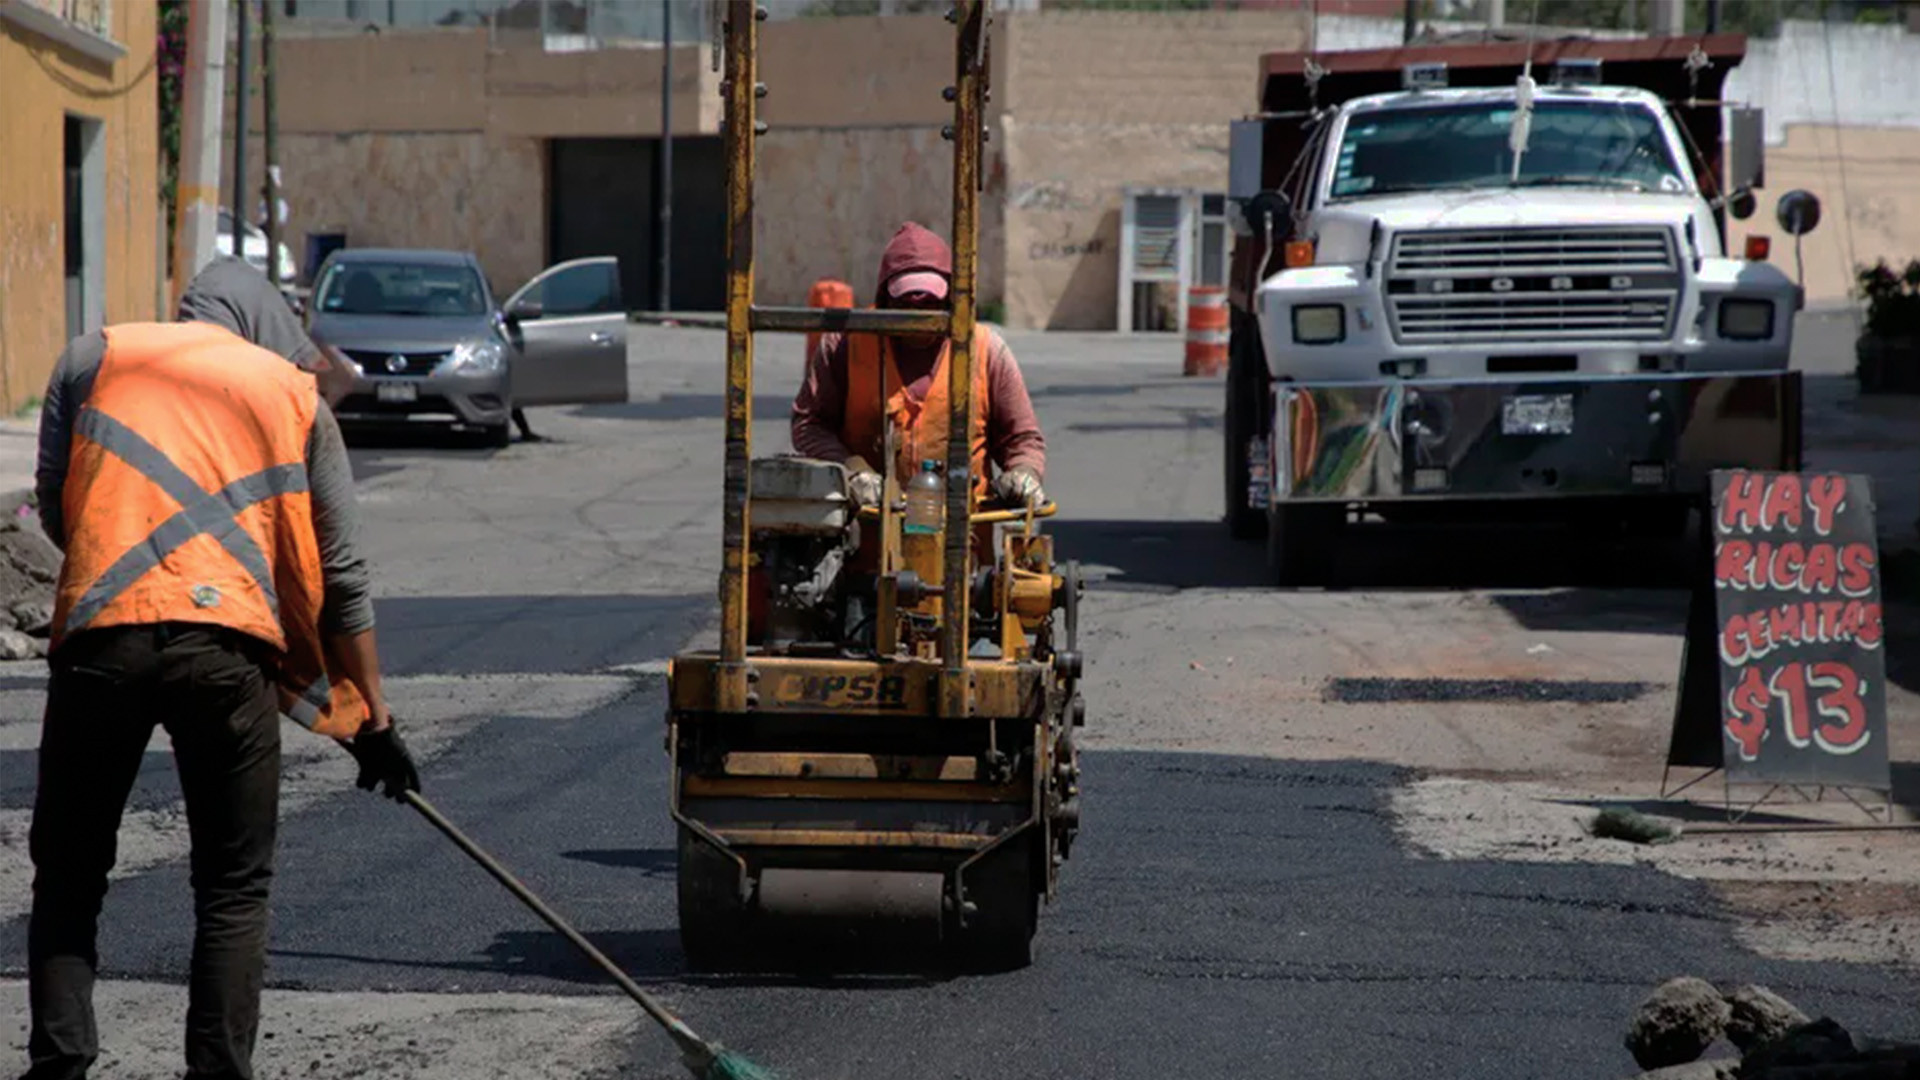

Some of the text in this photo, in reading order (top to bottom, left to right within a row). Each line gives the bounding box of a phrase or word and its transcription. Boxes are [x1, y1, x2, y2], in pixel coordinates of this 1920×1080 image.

[1433, 276, 1632, 292] FORD
[1718, 474, 1846, 535] HAY
[1715, 540, 1875, 597] RICAS
[1719, 601, 1883, 667] CEMITAS
[1725, 661, 1871, 761] $13
